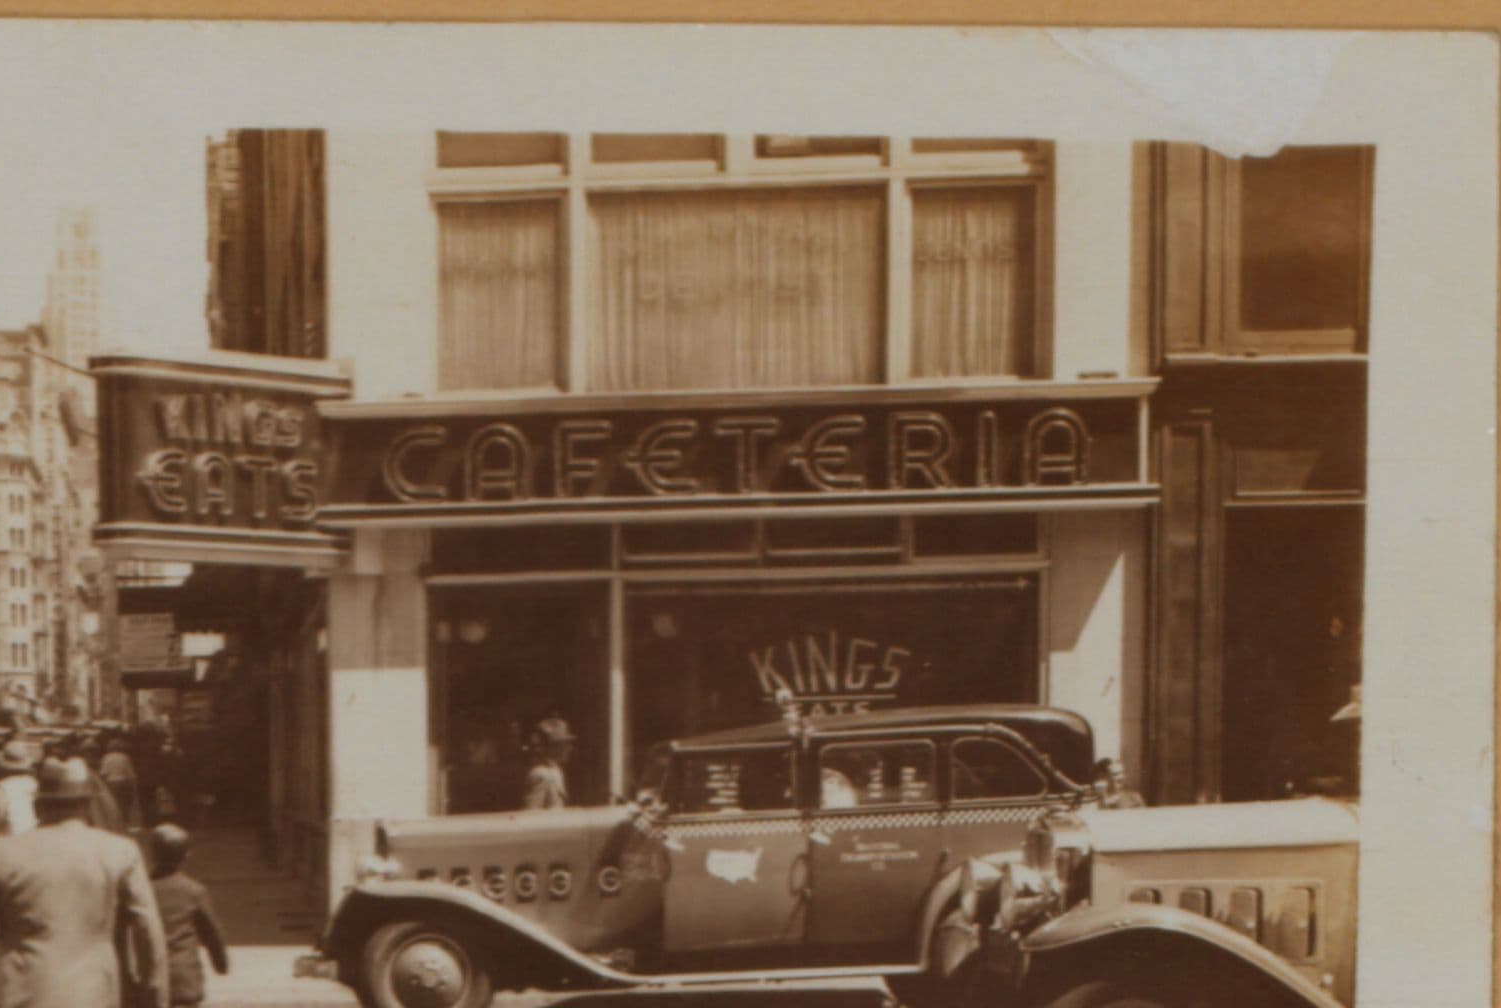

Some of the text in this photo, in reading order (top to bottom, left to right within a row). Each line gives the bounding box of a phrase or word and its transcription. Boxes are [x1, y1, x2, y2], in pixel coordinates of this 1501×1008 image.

[159, 393, 304, 447] KINGS
[134, 450, 318, 520] EATS
[382, 407, 1092, 502] CAFETERIA
[749, 629, 912, 692] KINGS
